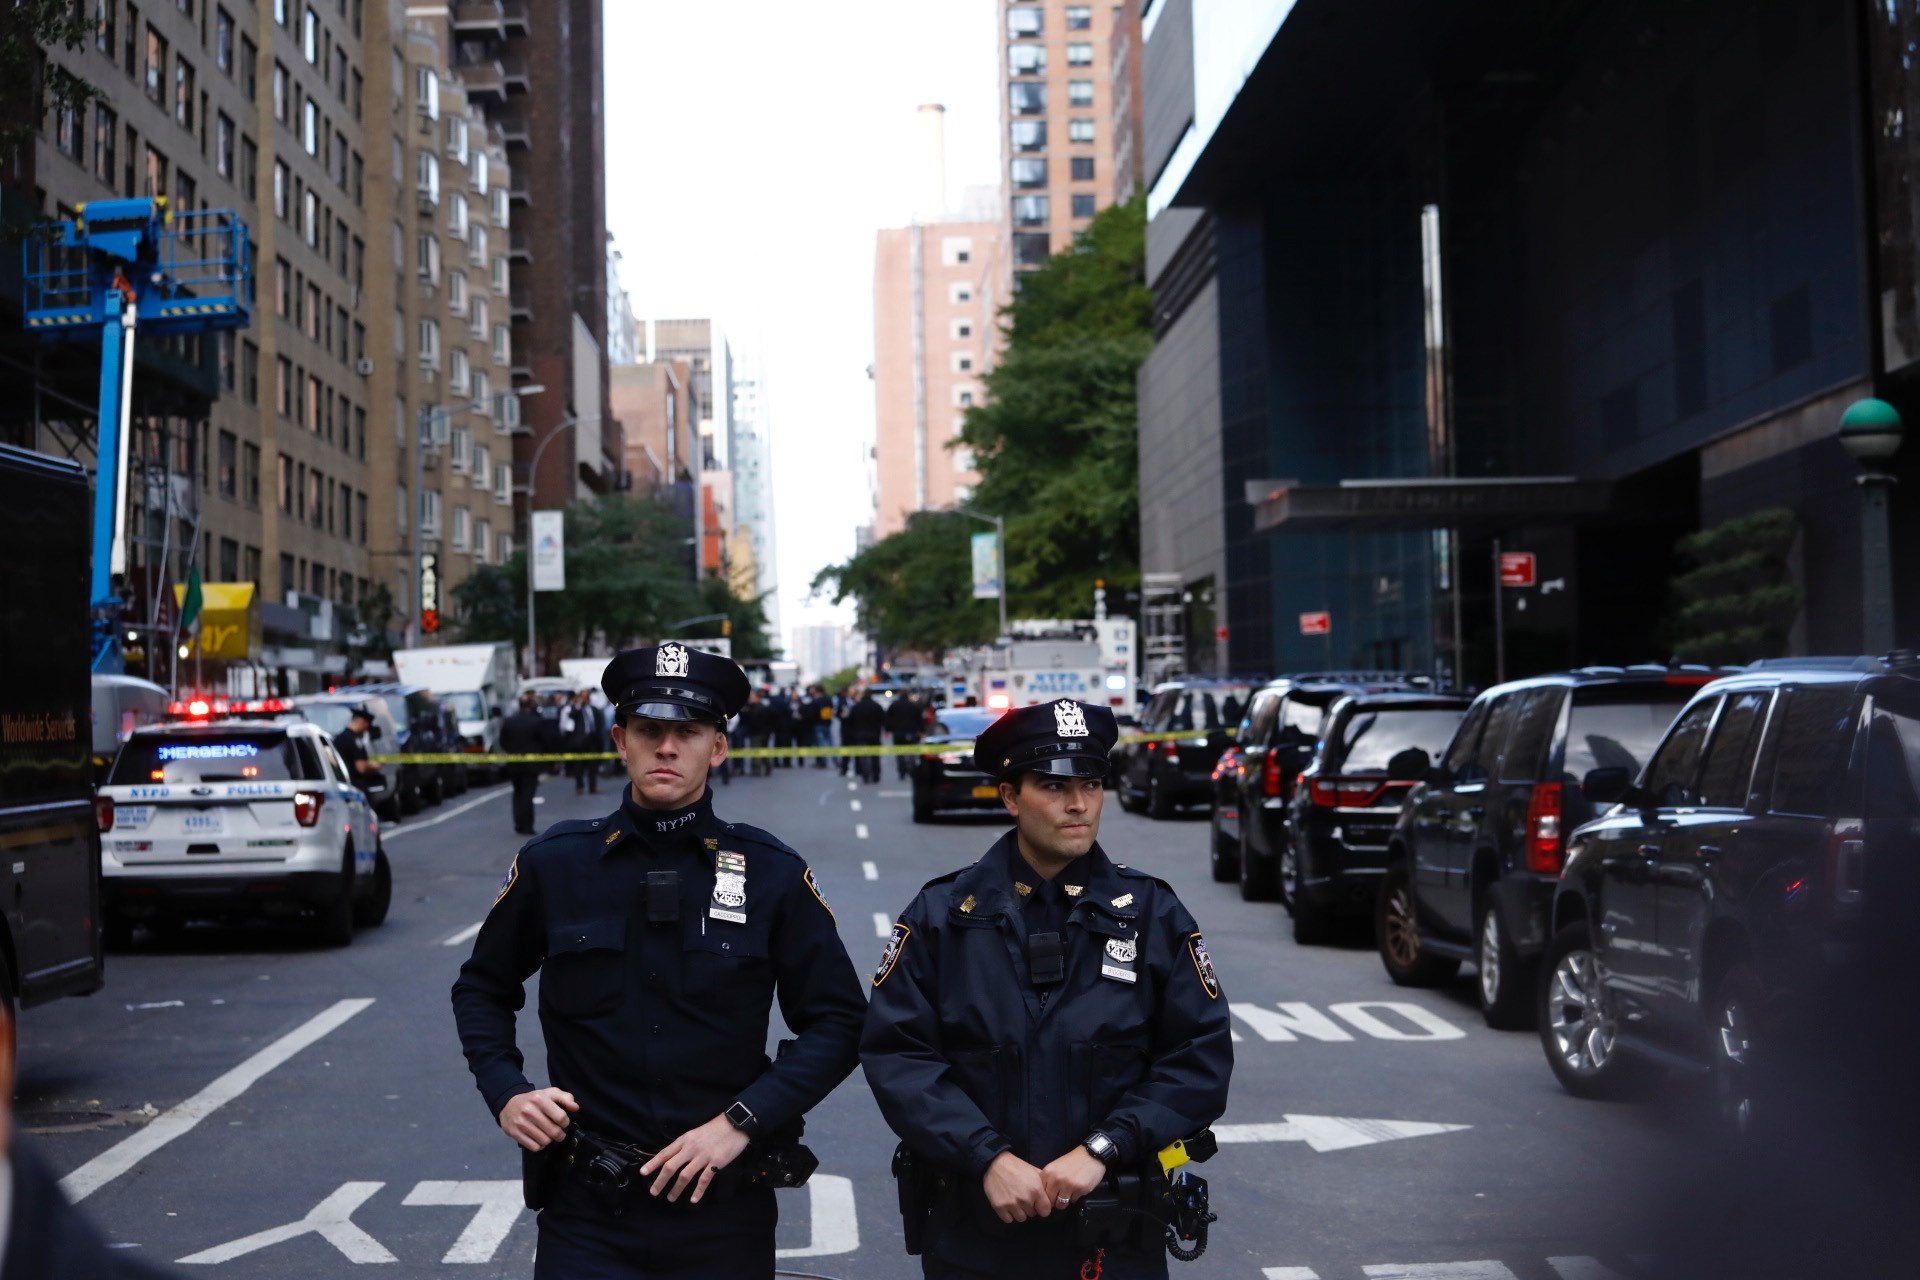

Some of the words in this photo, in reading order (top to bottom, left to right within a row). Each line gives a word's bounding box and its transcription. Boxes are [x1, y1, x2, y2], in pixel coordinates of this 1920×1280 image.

[1035, 672, 1079, 682] NYPD
[1028, 683, 1086, 693] POLICE
[2, 713, 43, 743] Worldwide
[45, 712, 76, 741] Services
[130, 787, 170, 798] NYPD
[227, 784, 283, 796] POLICE
[656, 812, 696, 833] NYPD
[1229, 1002, 1467, 1042] ON
